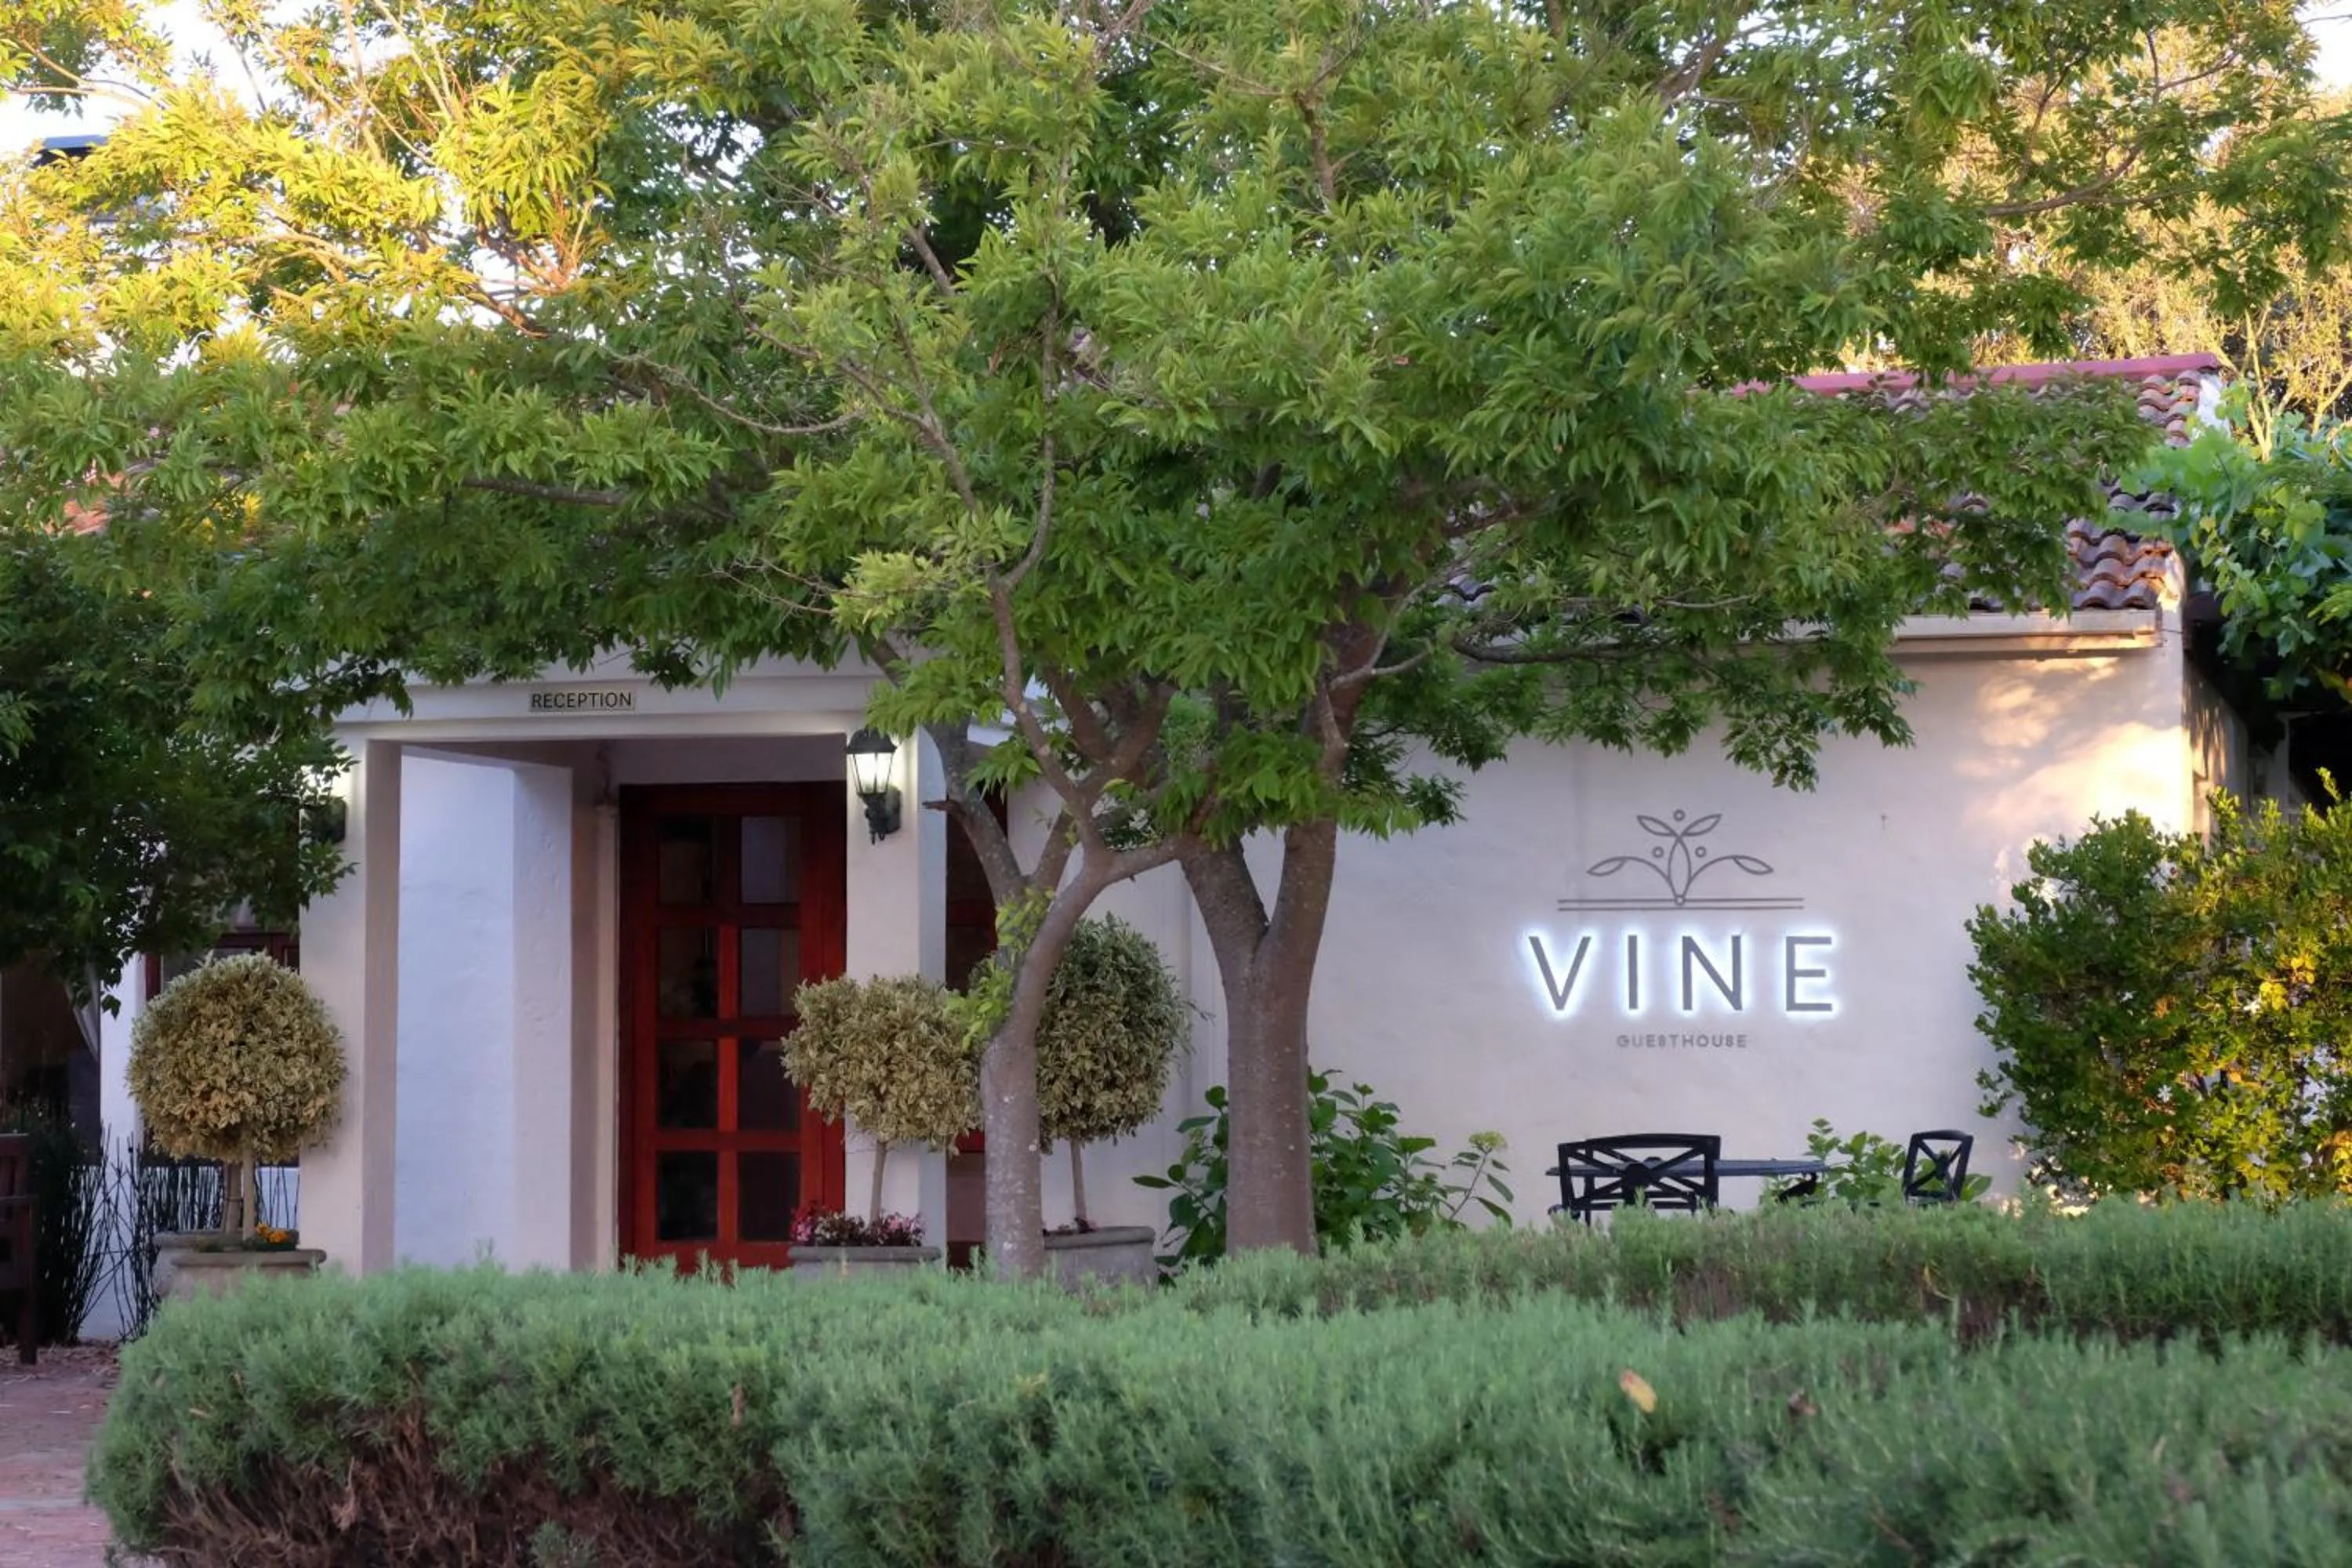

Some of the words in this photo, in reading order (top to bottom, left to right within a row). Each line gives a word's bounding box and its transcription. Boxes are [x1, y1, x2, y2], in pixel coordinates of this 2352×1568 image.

[532, 691, 632, 709] RECEPTION
[1528, 934, 1832, 1012] VINE
[1617, 1033, 1748, 1048] GUESTHOUSE
